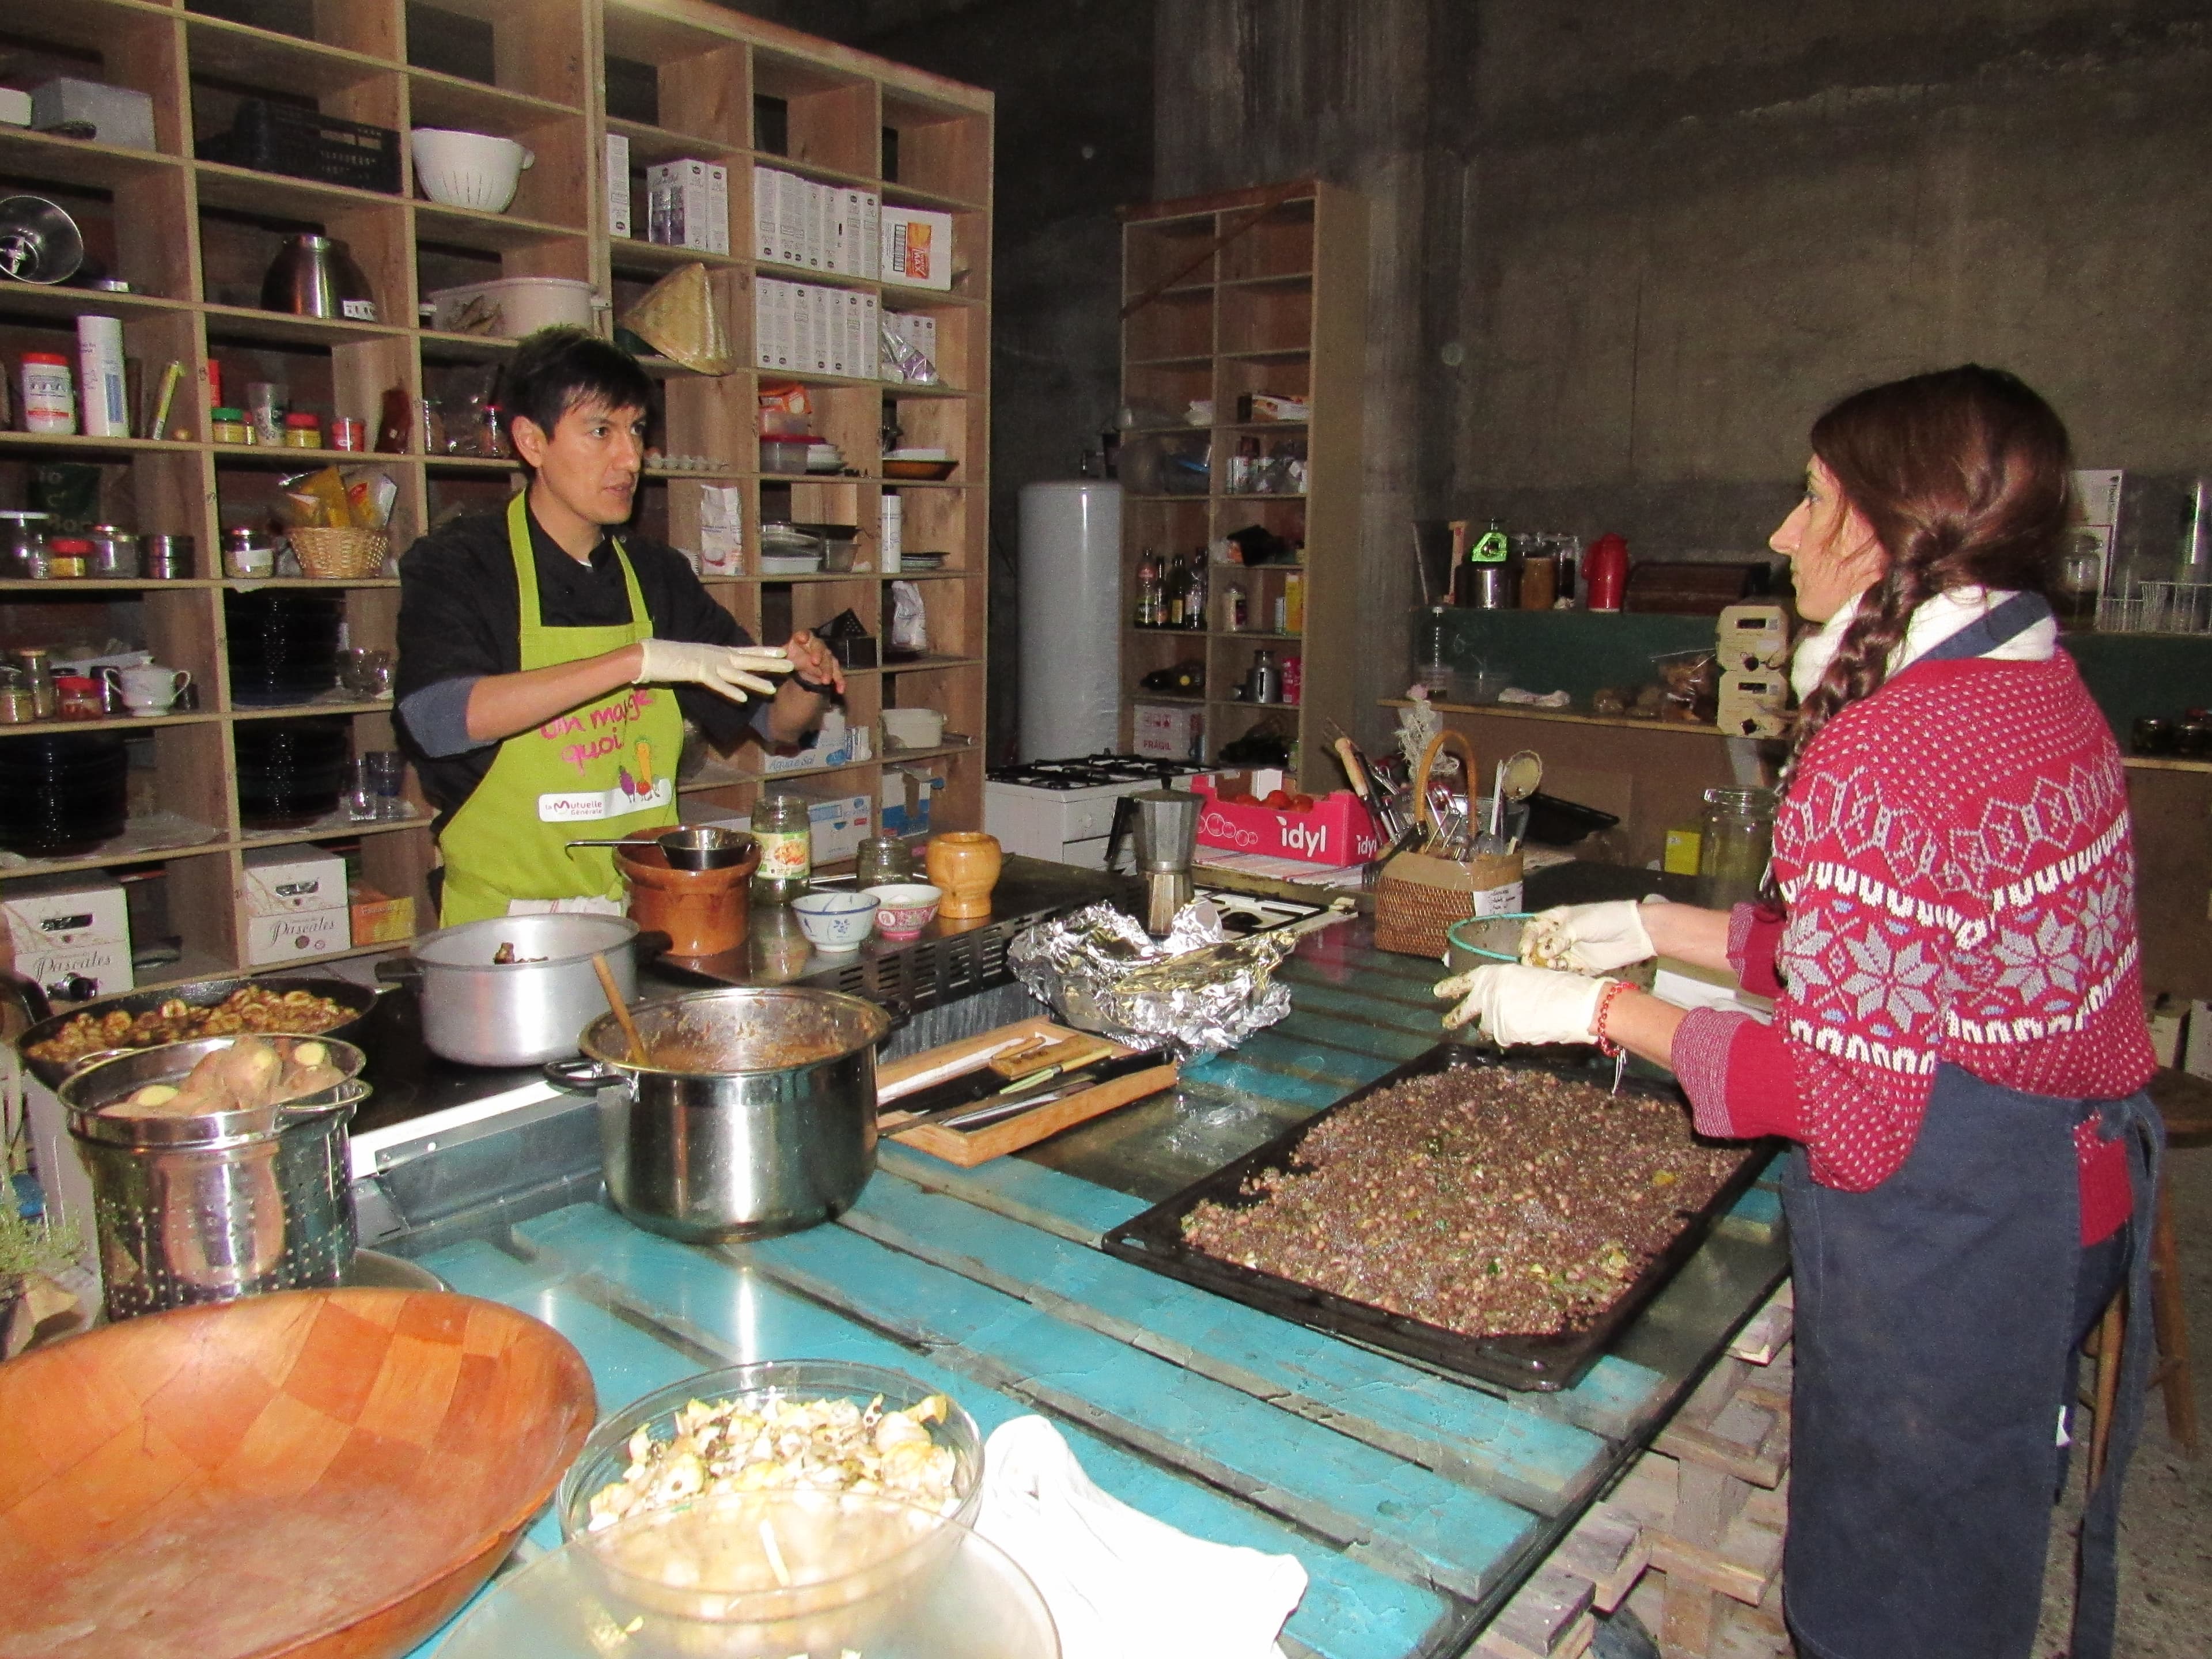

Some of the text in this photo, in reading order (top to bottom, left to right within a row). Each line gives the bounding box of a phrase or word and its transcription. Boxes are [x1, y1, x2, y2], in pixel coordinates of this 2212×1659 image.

[561, 726, 624, 777] quoi
[553, 800, 603, 813] Mutuelle
[1275, 815, 1327, 858] idyl
[1355, 834, 1377, 859] idyl
